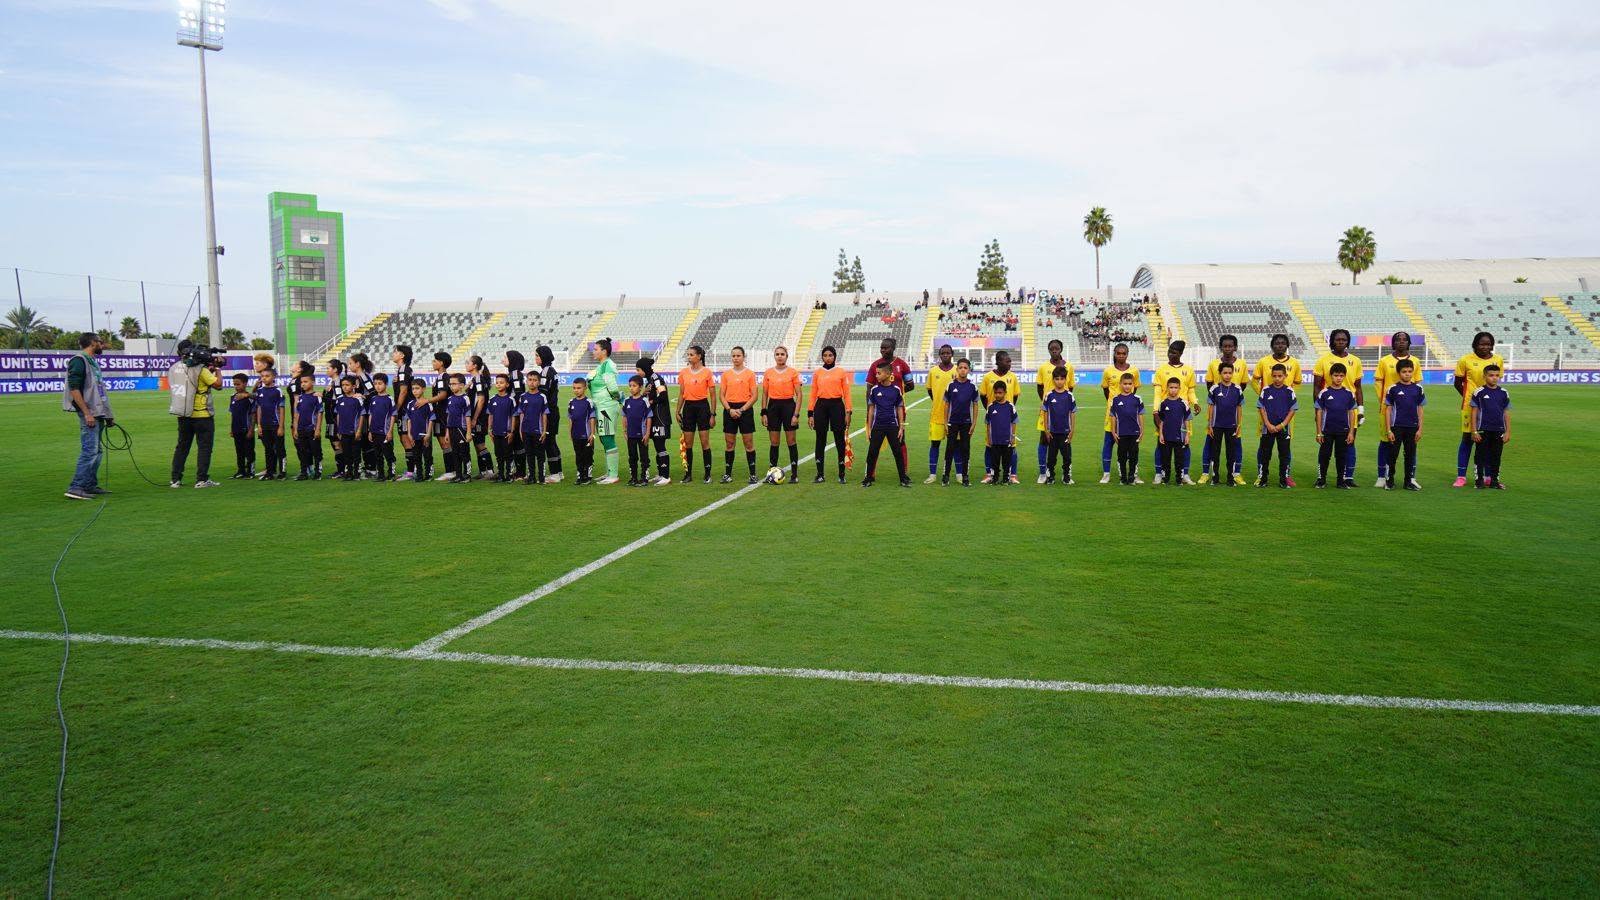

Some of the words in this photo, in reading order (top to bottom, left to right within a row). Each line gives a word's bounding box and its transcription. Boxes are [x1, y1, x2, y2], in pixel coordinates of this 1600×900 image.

[1, 357, 49, 369] UNITES
[109, 358, 145, 369] SERIES
[1526, 372, 1590, 383] WOMEN'S
[0, 382, 23, 393] TES
